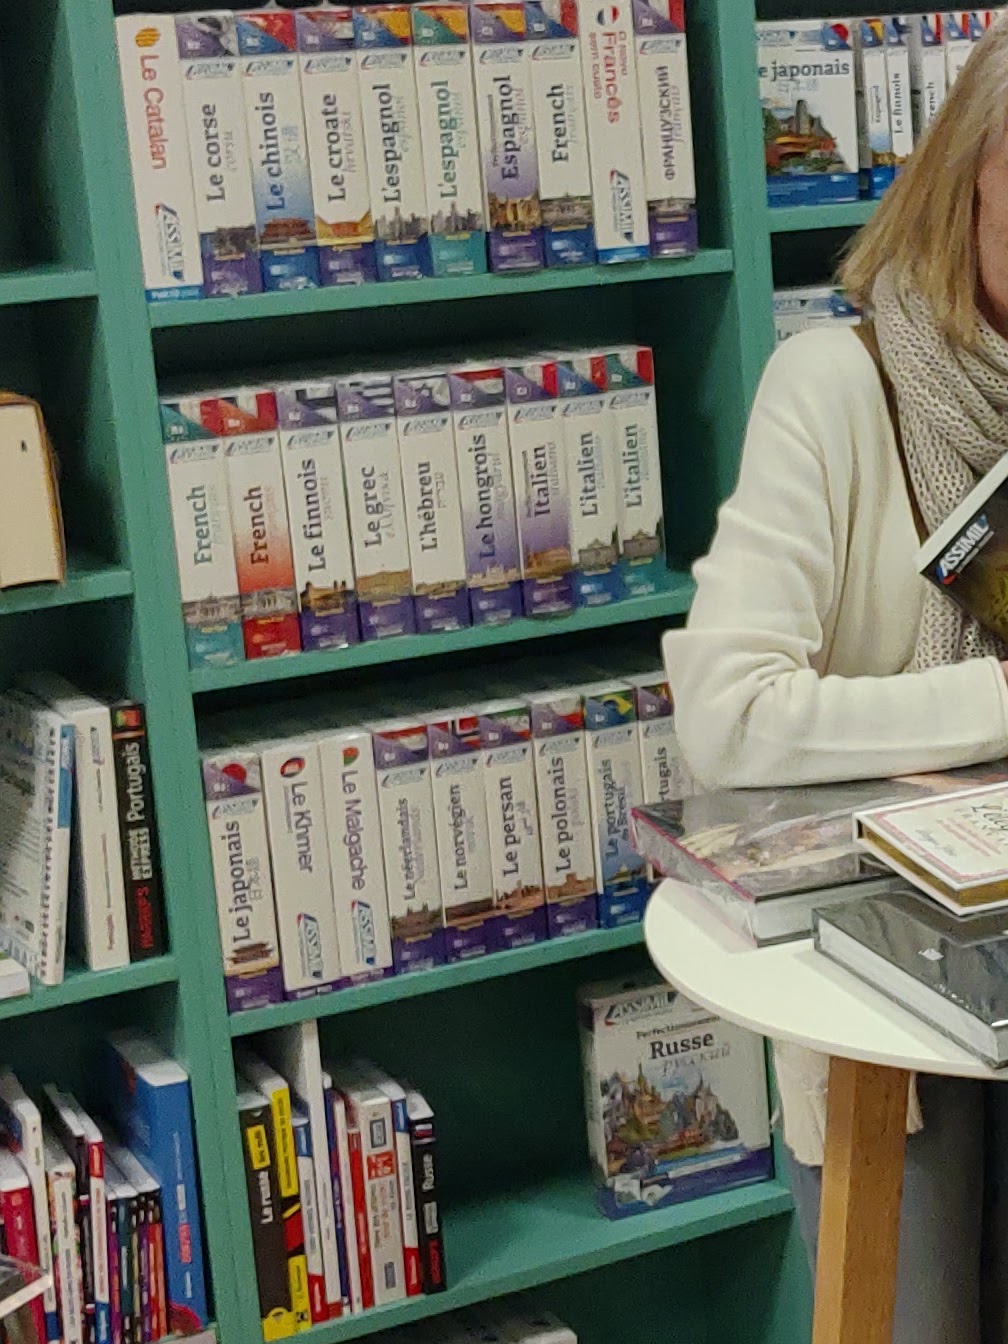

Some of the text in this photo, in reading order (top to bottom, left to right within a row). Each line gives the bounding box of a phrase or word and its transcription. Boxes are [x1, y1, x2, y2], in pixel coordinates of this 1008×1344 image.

[140, 54, 168, 170] Le Catalan
[601, 31, 621, 124] Francês
[770, 59, 850, 83] japonais
[201, 102, 226, 203] Le corse
[254, 91, 286, 212] Le chinois
[321, 93, 347, 204] Le croate
[372, 82, 400, 204] L'espagnol
[430, 79, 459, 199] L'espagnol
[492, 74, 519, 181] Espagnol
[546, 82, 570, 164] French
[355, 466, 384, 550] Le grec
[416, 460, 440, 554] L'hébreu
[467, 432, 496, 559] Le hongrois
[530, 444, 551, 518] Italien
[576, 430, 600, 517] L'italien
[621, 422, 644, 509] L'italien
[185, 484, 212, 566] French
[243, 484, 269, 566] French
[297, 457, 327, 573] Le finnois
[125, 742, 147, 823] Portugais
[547, 756, 574, 874] Le polonais
[598, 758, 621, 858] Le portugais
[654, 746, 672, 802] rtugais
[292, 781, 314, 874] Le Khmer
[342, 770, 366, 892] Le Malgache
[449, 783, 469, 891] Le norvégien
[499, 775, 522, 877] Le persan
[221, 820, 254, 944] Le japonais
[403, 883, 415, 902] Le
[650, 1032, 715, 1060] Russe
[421, 1153, 436, 1192] Russe
